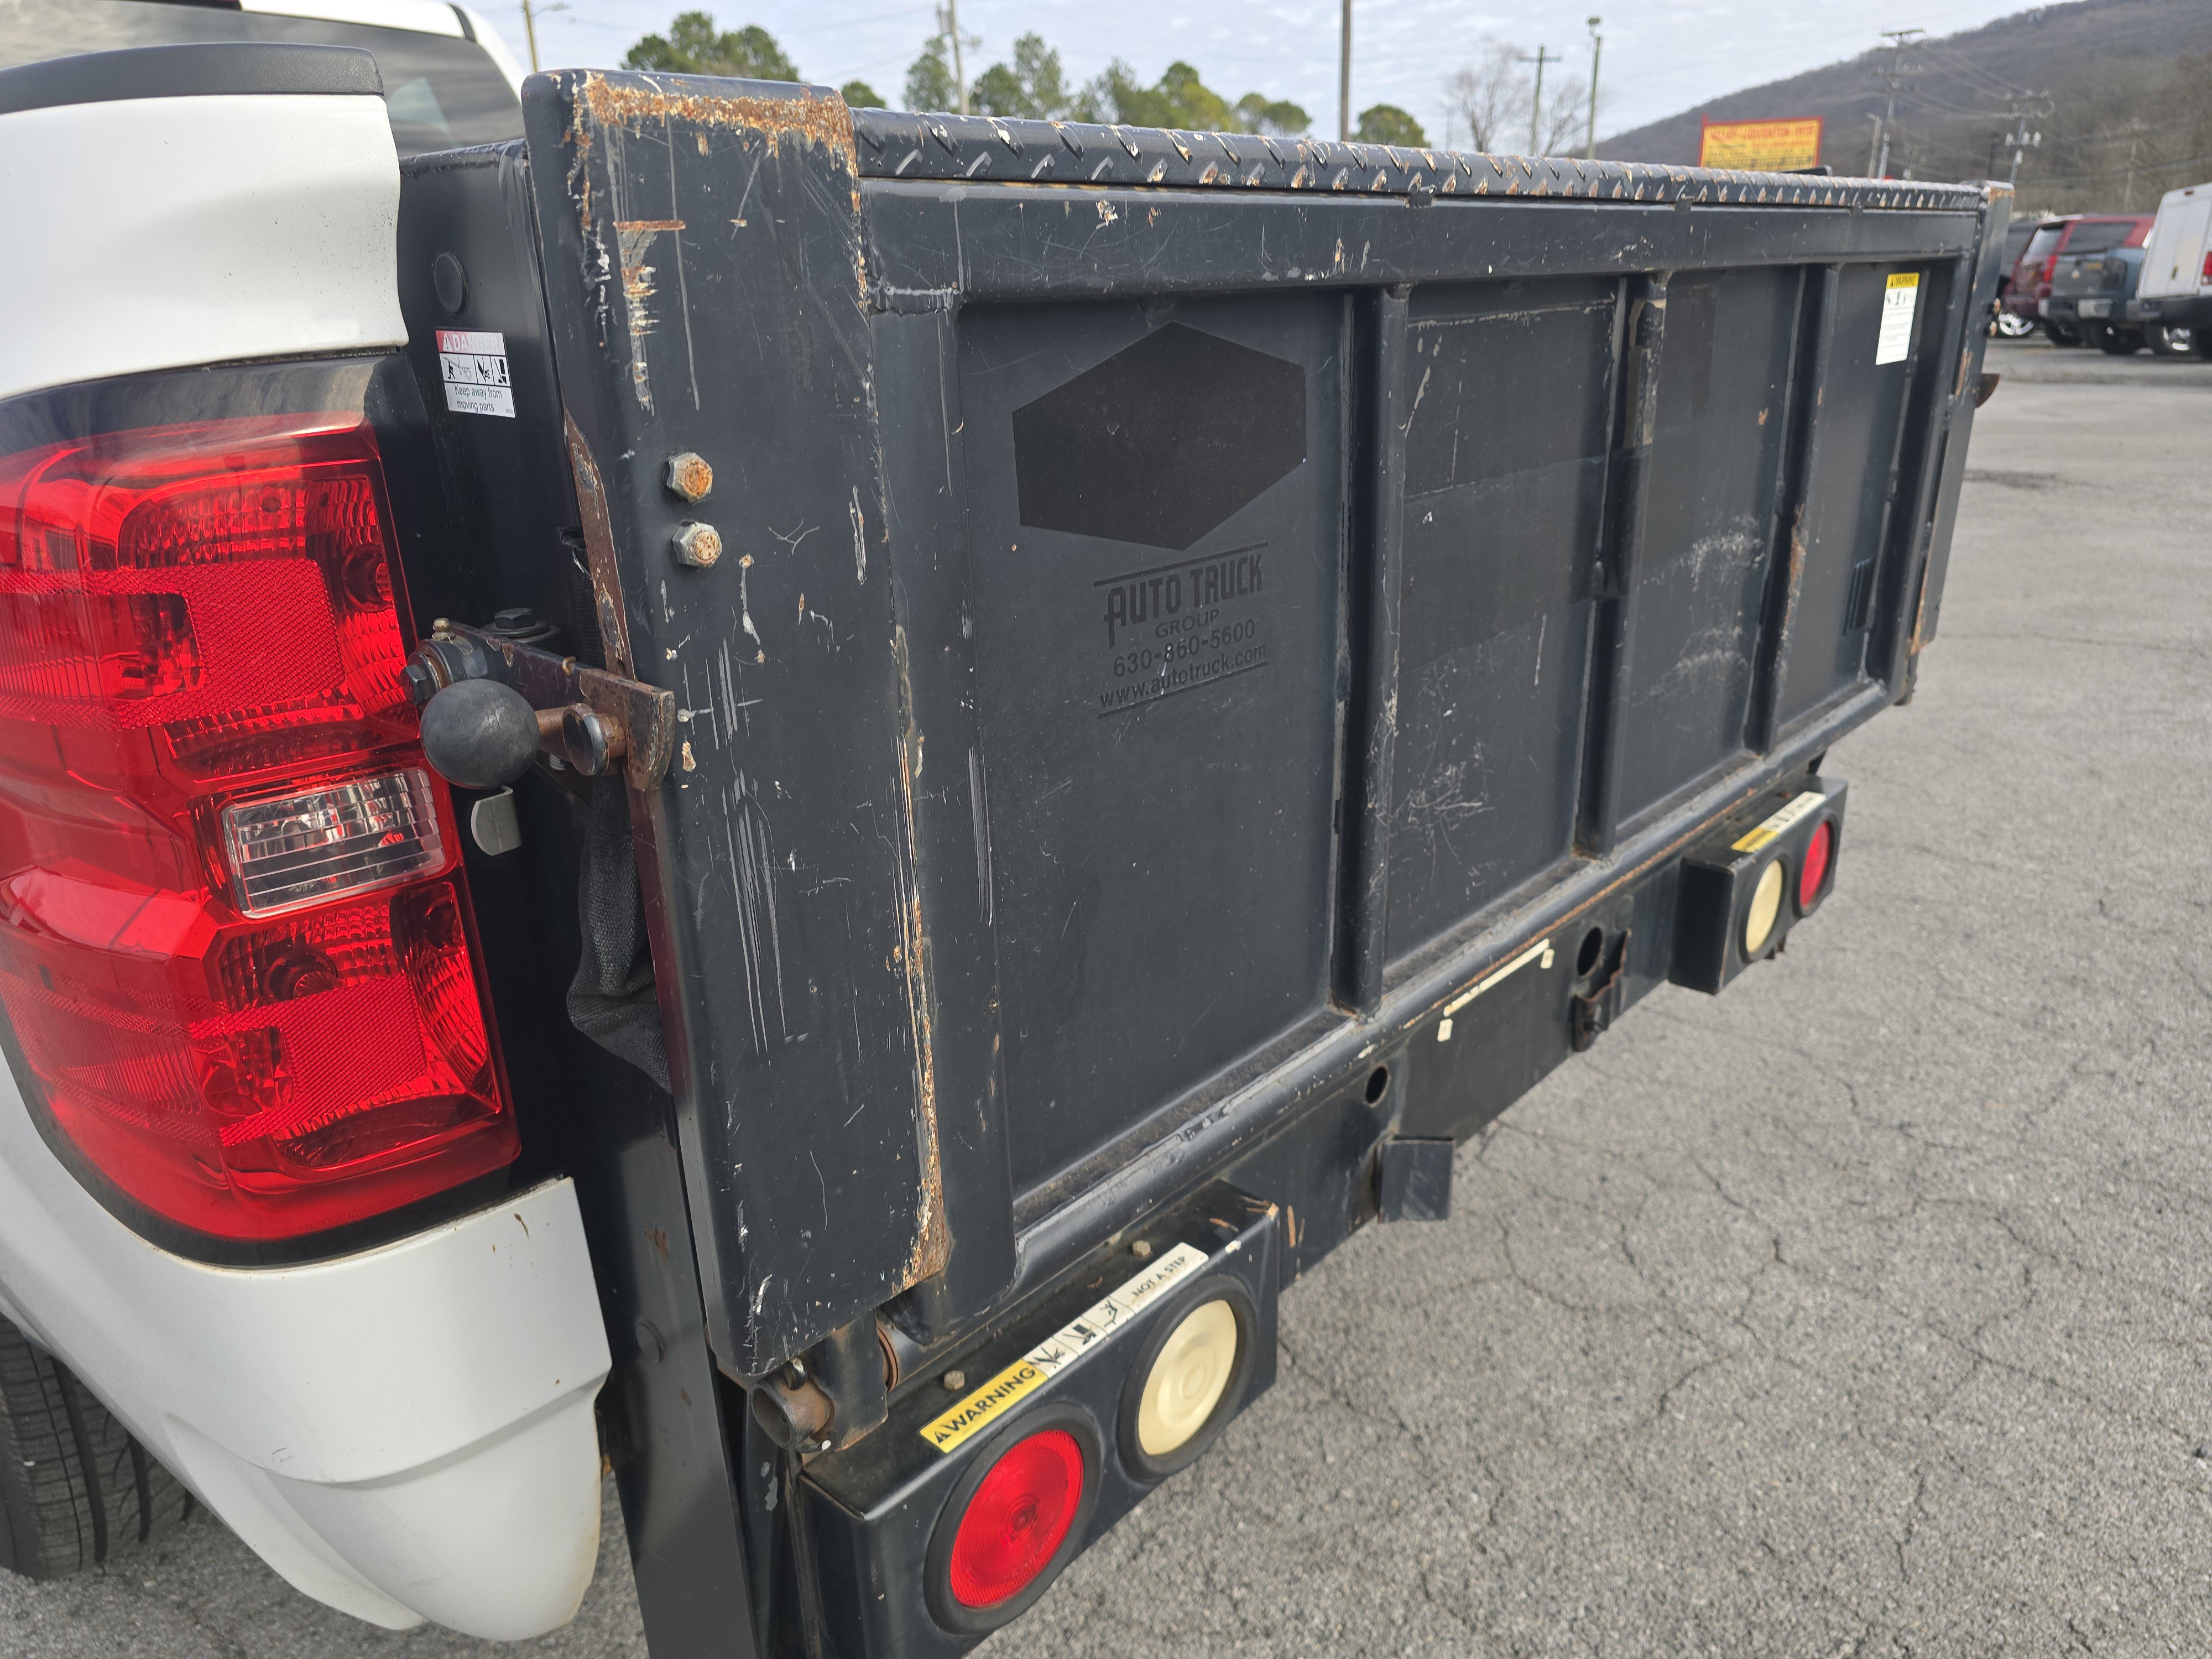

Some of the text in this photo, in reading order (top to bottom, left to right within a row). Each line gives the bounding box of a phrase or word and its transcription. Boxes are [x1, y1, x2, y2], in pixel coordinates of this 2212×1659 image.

[452, 333, 498, 353] DANGER
[455, 384, 502, 400] Keep away from
[457, 399, 478, 413] moving
[479, 402, 494, 414] parts
[1104, 553, 1264, 650] AUTO TRUCK
[1154, 608, 1220, 639] GROUP
[1113, 618, 1255, 677] 630-860-5600
[1100, 641, 1267, 708] www.autotruck.com
[1131, 1279, 1155, 1297] NOT
[1164, 1256, 1185, 1272] STEP
[944, 1366, 1036, 1432] WARNING
